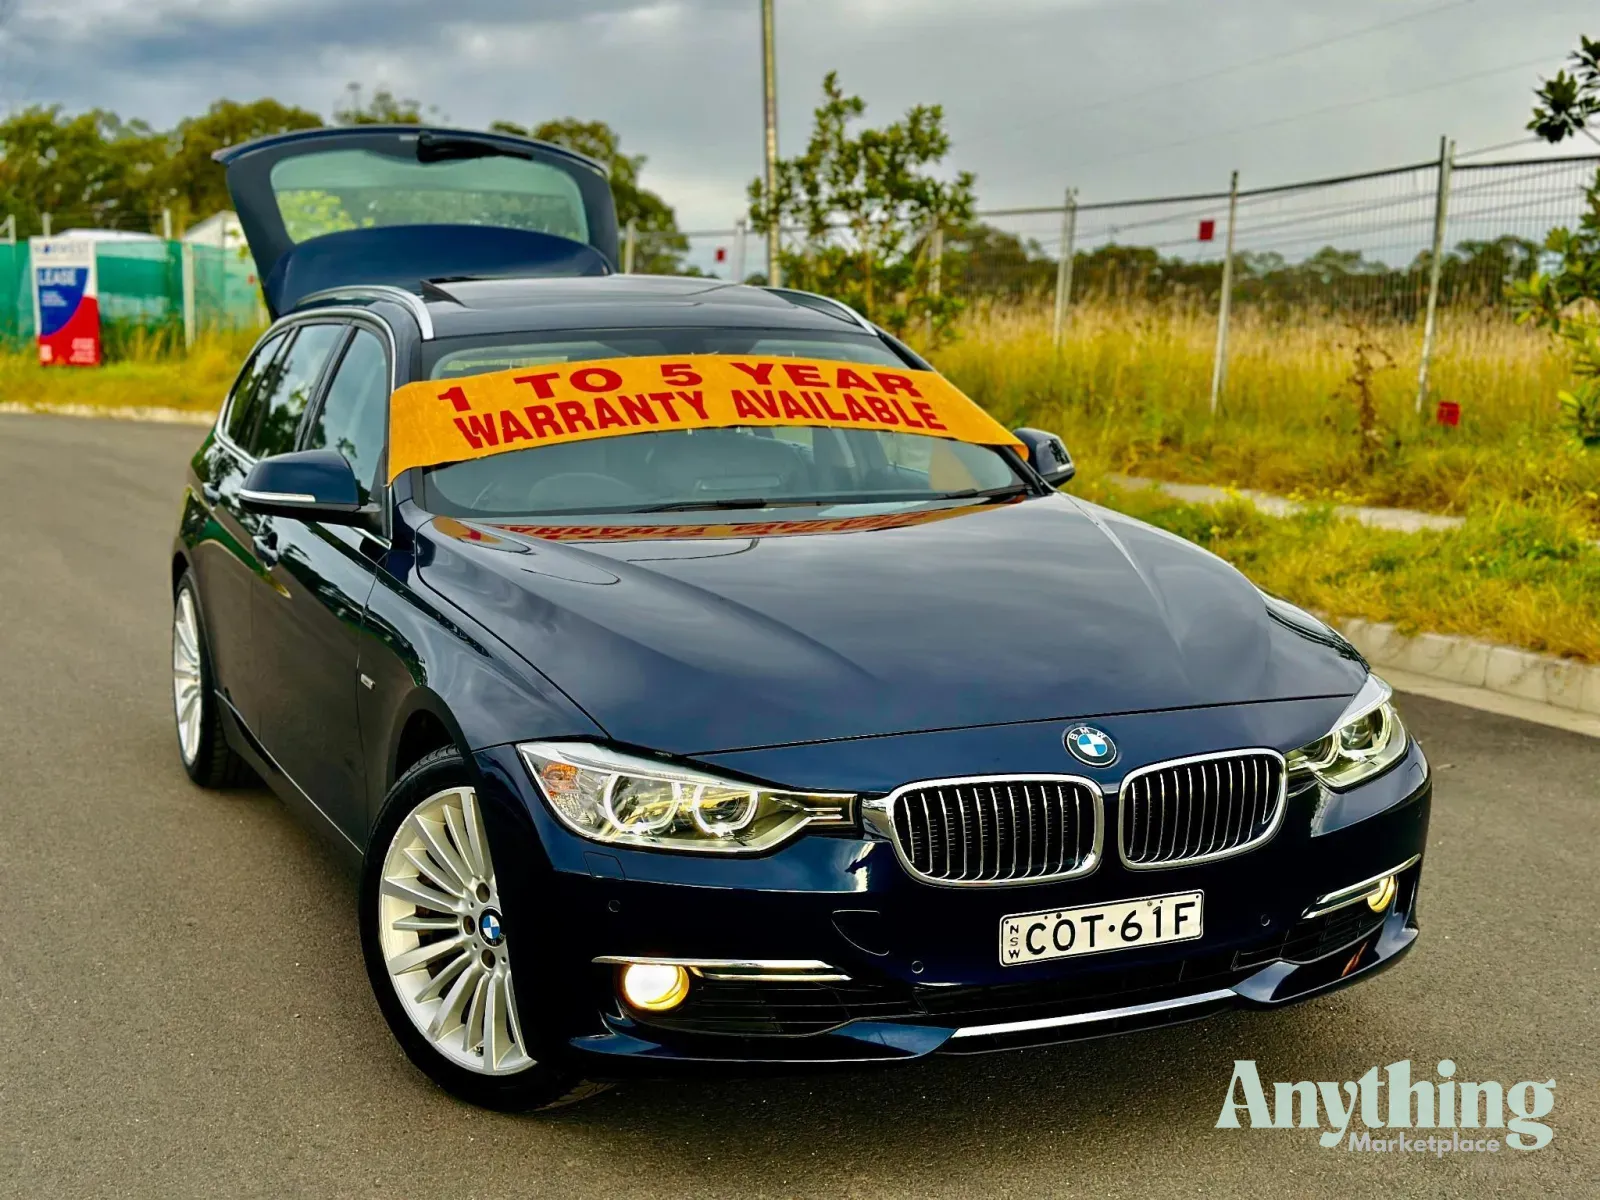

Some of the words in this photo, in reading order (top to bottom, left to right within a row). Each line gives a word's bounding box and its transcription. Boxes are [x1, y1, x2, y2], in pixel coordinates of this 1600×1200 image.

[438, 387, 471, 412] 1
[514, 368, 623, 399] TO
[661, 364, 703, 387] 5
[729, 362, 924, 398] YEAR
[453, 391, 709, 449] WARRANTY
[730, 390, 948, 431] AVAILABLE
